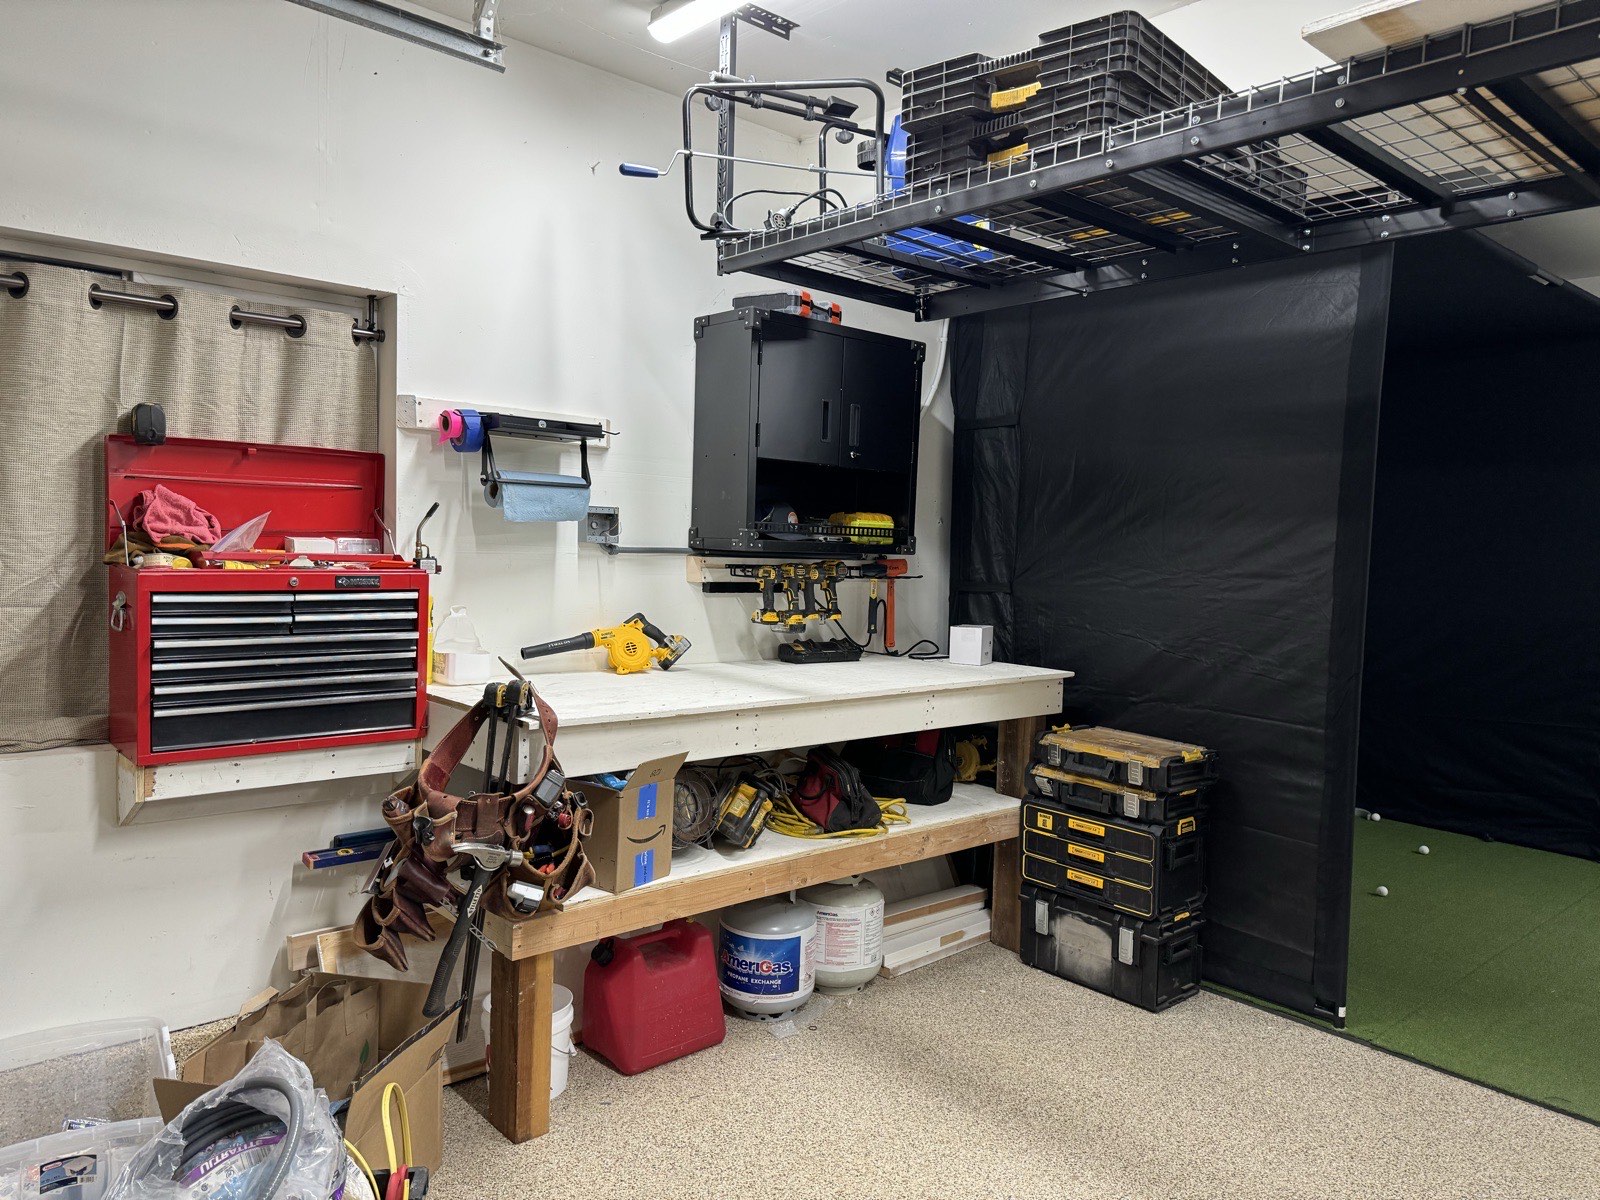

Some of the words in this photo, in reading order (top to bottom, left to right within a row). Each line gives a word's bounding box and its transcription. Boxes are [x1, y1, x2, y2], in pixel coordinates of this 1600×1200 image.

[469, 889, 482, 914] STILETTO
[721, 949, 792, 974] AmeriGas
[727, 971, 748, 982] PROPANE
